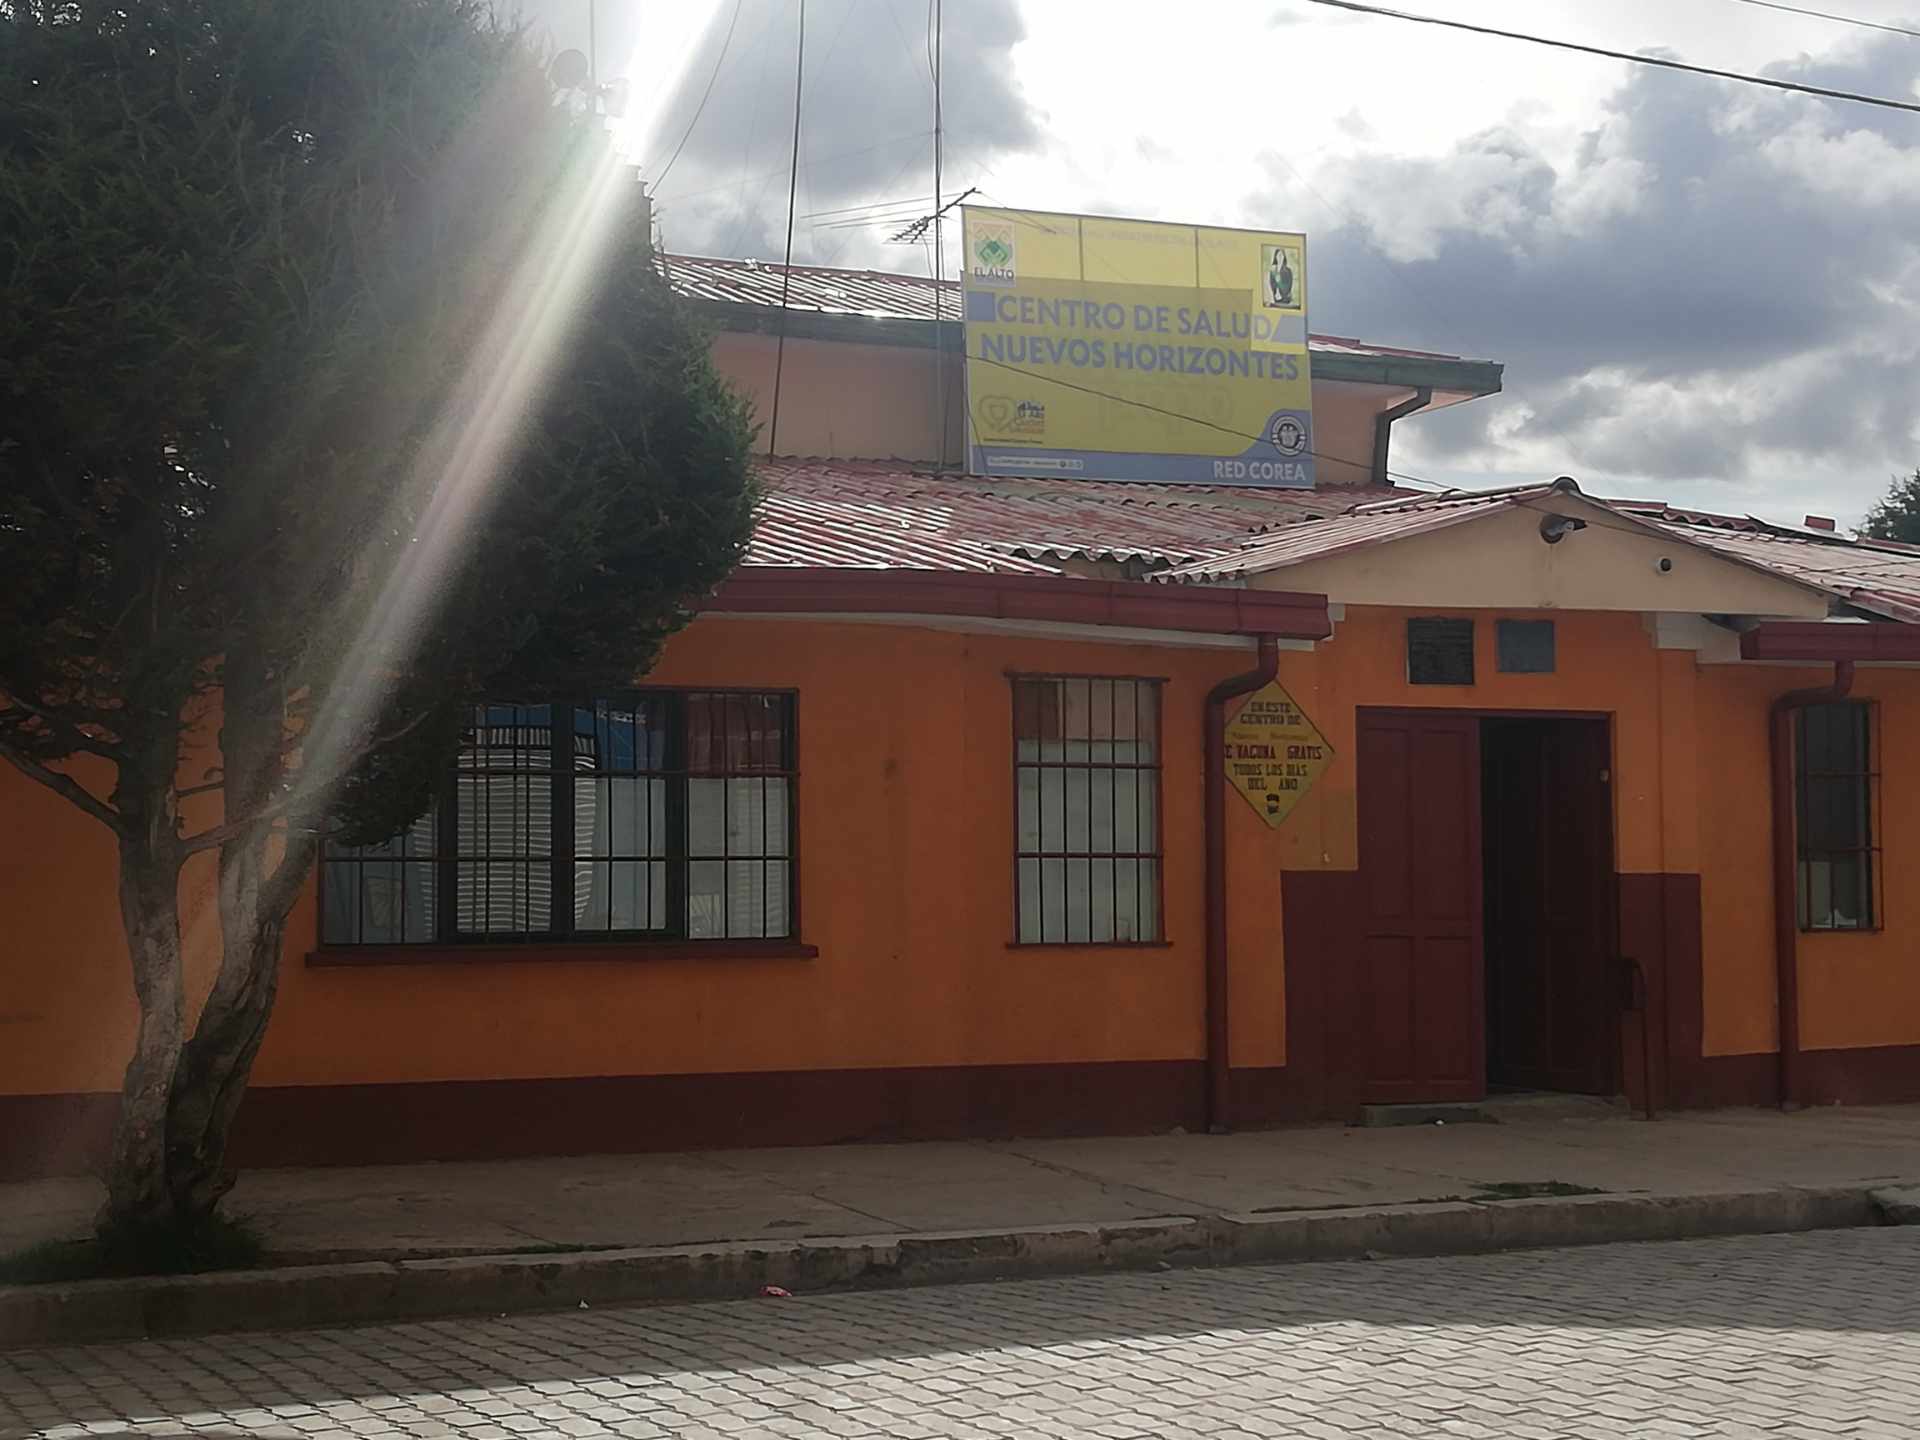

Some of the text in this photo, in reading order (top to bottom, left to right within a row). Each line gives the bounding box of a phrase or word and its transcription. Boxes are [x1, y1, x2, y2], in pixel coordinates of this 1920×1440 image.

[974, 267, 1014, 280] EL ALTO
[996, 295, 1273, 342] CENTRO DE SALUD
[981, 333, 1298, 381] NUEVOS HORIZONTES
[1213, 460, 1306, 482] RED COREA
[1265, 702, 1291, 713] ESTE
[1240, 713, 1285, 724] CENTRO
[1236, 744, 1276, 759] VACUNA
[1287, 745, 1322, 760] GRATIS
[1234, 763, 1262, 776] TODOS
[1266, 763, 1282, 776] LOS
[1248, 777, 1267, 790] DEL
